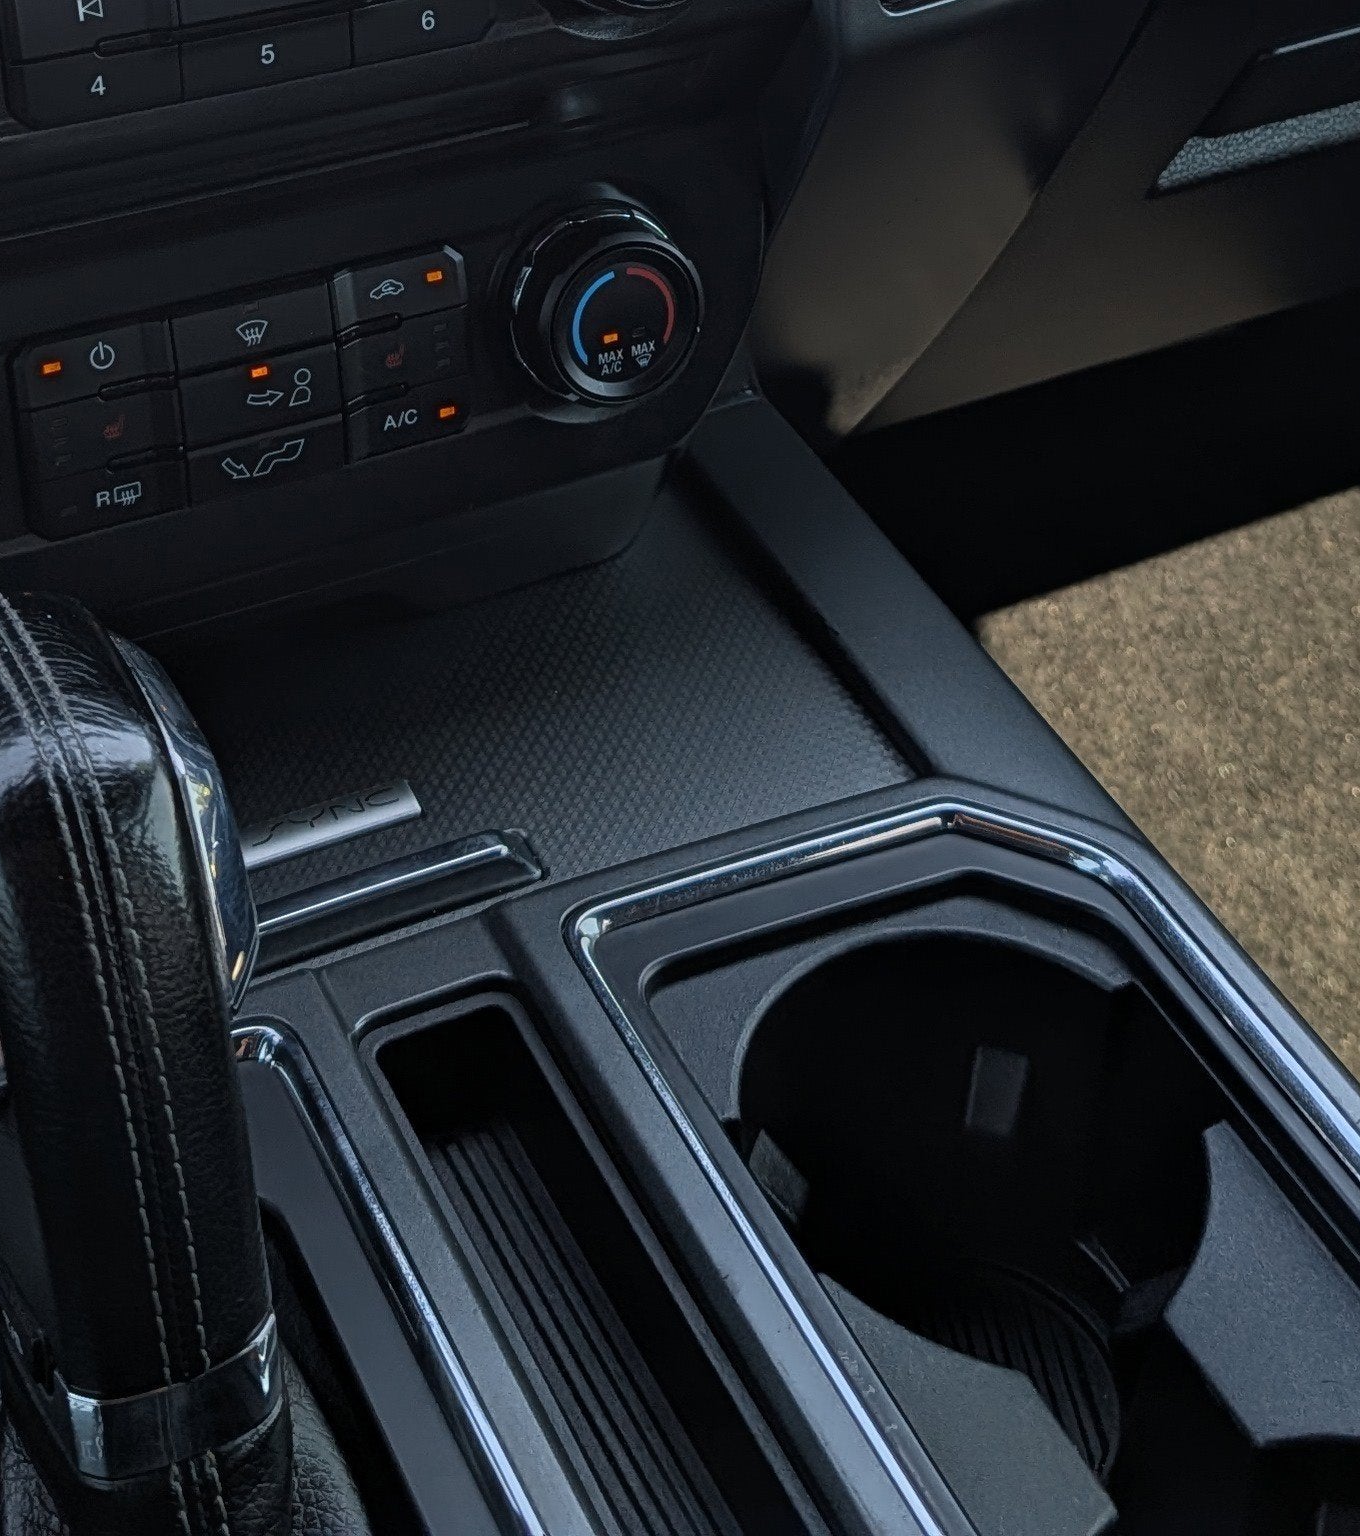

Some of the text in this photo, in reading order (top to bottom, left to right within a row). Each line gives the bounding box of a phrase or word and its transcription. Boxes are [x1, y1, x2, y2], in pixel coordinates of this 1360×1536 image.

[421, 9, 435, 31] 6
[261, 43, 275, 65] 5
[90, 75, 107, 96] 4
[598, 348, 624, 366] MAX
[631, 340, 655, 357] MAX
[601, 360, 622, 376] A/C
[383, 408, 418, 431] A/C
[96, 490, 111, 508] R
